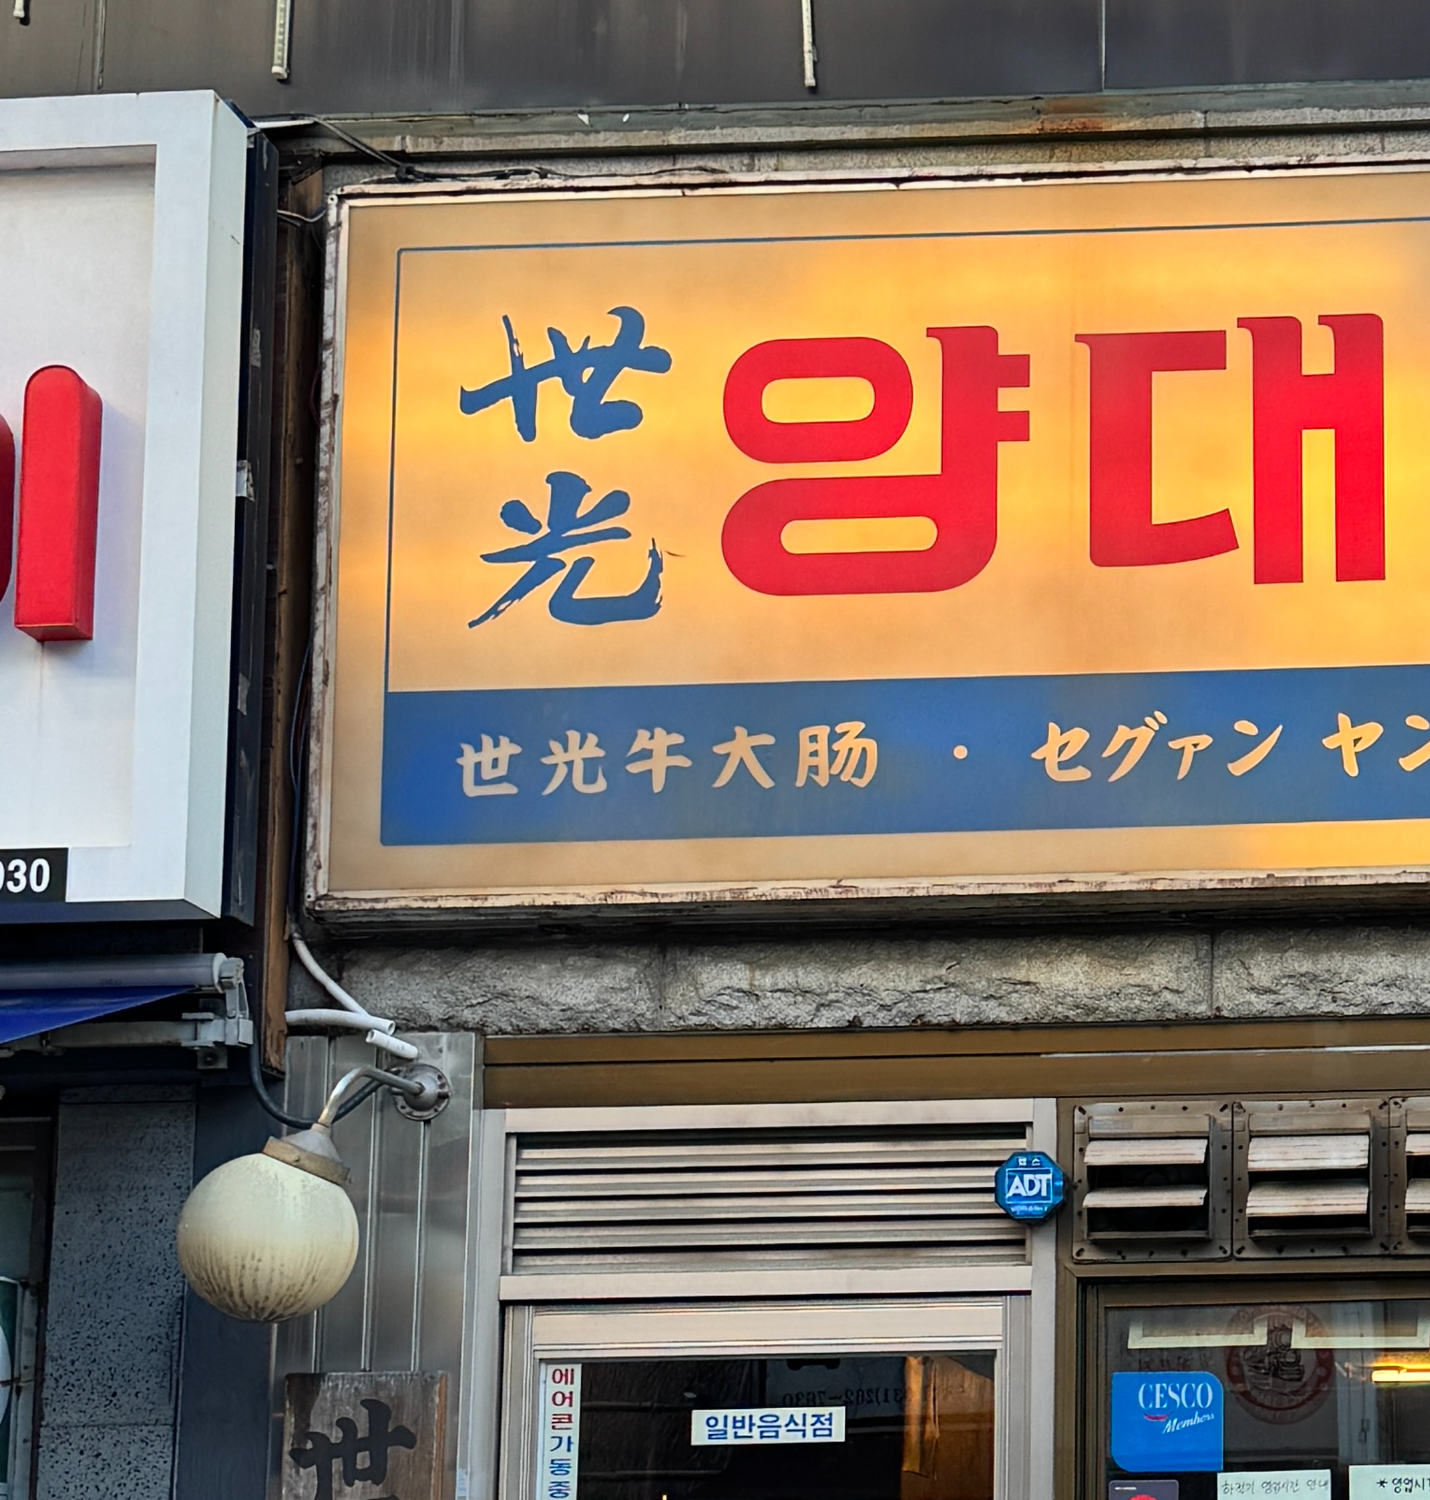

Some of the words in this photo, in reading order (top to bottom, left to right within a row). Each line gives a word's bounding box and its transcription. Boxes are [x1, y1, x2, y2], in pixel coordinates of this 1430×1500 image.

[459, 303, 674, 630] 世光
[1005, 1173, 1052, 1198] ADT
[1138, 1382, 1213, 1410] CESCO
[704, 1411, 835, 1441] 일반음식점
[1161, 1413, 1215, 1435] Members
[1261, 1479, 1300, 1495] 영업시간
